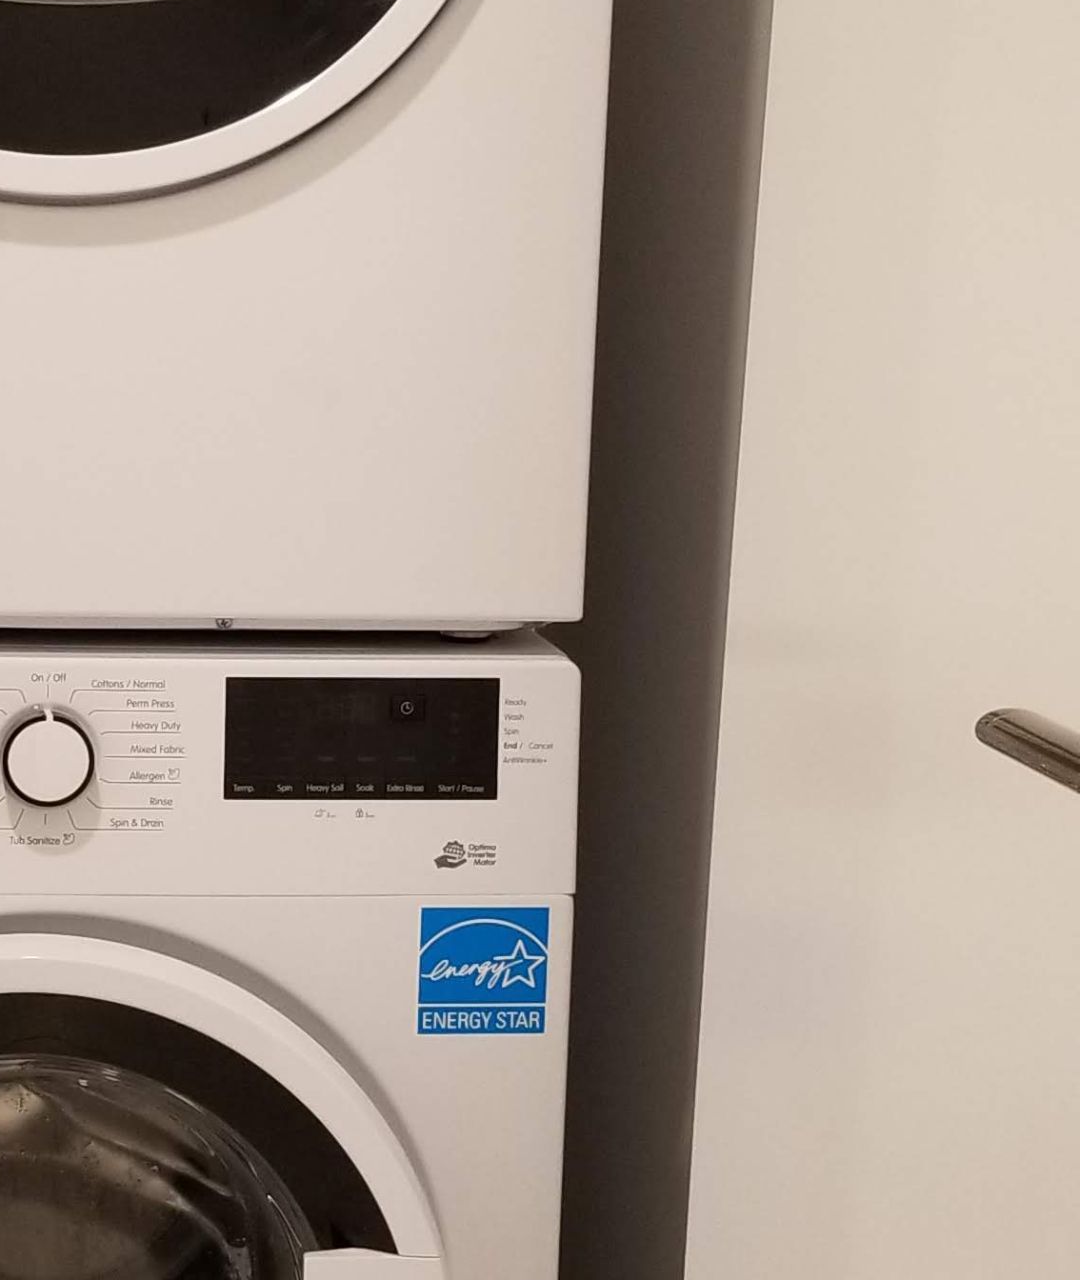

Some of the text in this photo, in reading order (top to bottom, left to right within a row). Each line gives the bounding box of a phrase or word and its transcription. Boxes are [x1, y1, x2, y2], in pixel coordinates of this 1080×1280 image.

[30, 673, 44, 683] On
[52, 672, 67, 683] Off
[91, 679, 125, 689] Cottons
[133, 679, 166, 689] Normal
[126, 699, 175, 709] Perm Press
[131, 721, 182, 731] Heavy Duty
[130, 744, 185, 754] Mixed Fabric
[503, 741, 518, 750] End
[129, 771, 166, 782] Allergen
[276, 783, 294, 793] Spin
[306, 783, 344, 793] Heavy Soil
[355, 783, 375, 792] Soak
[386, 784, 404, 793] Extra
[438, 784, 455, 793] Start
[461, 784, 485, 793] Pause
[149, 797, 173, 806] Rinse
[110, 818, 130, 829] Spin
[140, 818, 164, 828] Drain
[10, 835, 61, 846] Tub Sanitize
[421, 959, 512, 989] energy
[422, 1010, 541, 1030] ENERGY STAR
